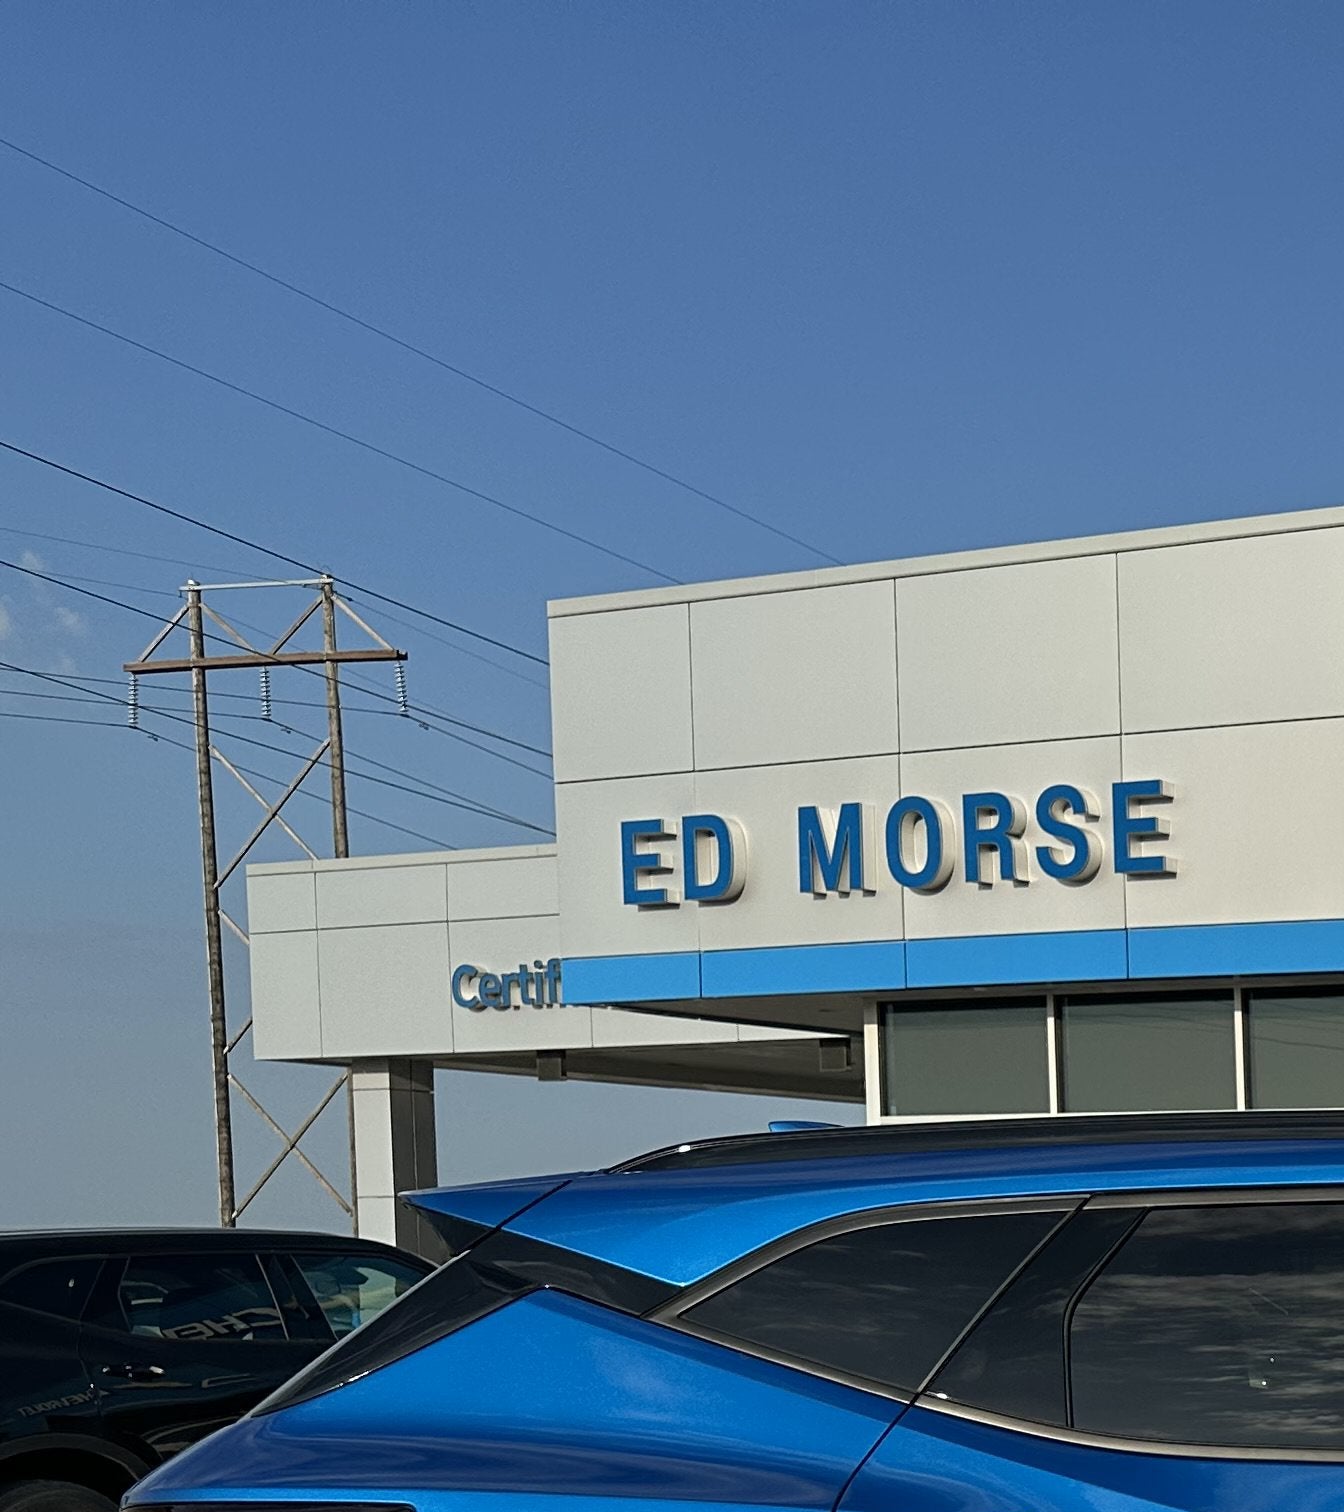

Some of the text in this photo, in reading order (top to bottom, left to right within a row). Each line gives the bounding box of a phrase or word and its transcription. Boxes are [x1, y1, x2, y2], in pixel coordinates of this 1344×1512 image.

[621, 779, 1177, 906] ED MORSE
[452, 958, 561, 1010] Certif
